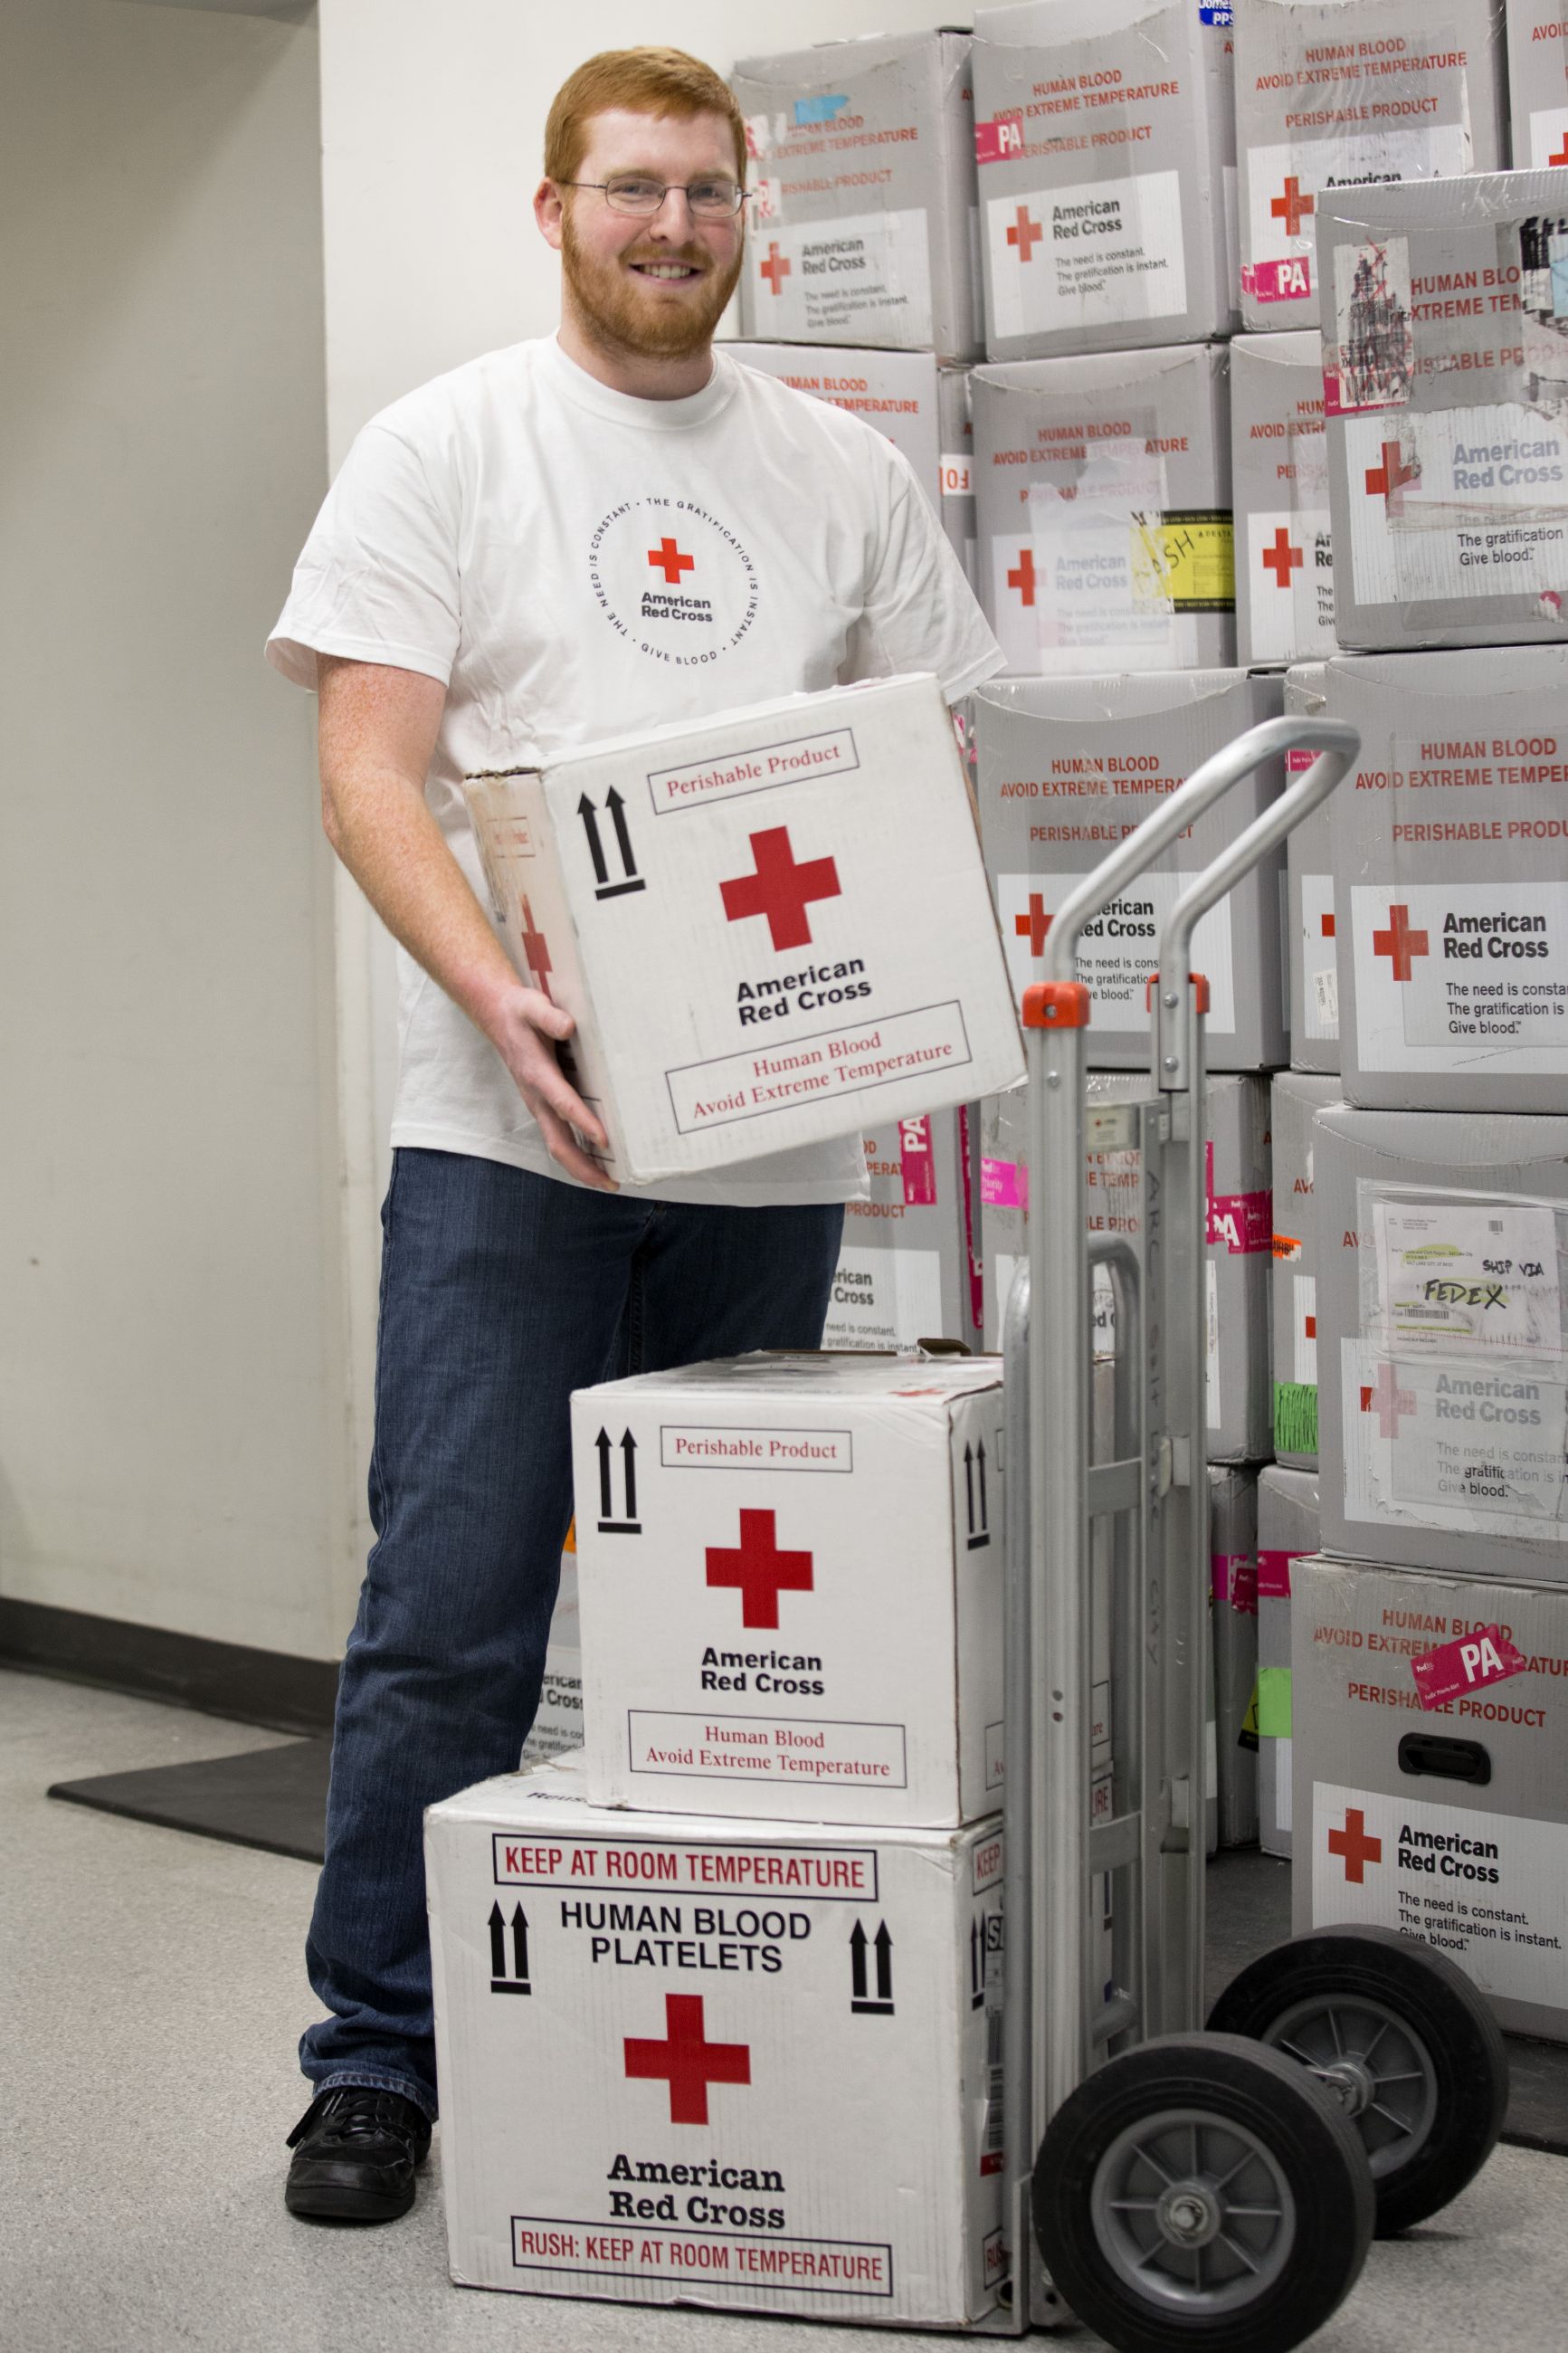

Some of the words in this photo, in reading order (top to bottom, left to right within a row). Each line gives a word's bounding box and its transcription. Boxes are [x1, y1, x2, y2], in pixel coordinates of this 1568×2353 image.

[1306, 44, 1354, 62] HUMAN
[1358, 38, 1406, 57] BLOOD
[1256, 73, 1294, 90] AVOID
[1297, 65, 1360, 84] EXTREME
[1364, 52, 1467, 76] TEMPERATURE
[1033, 78, 1076, 97] HUMAN
[1079, 70, 1122, 89] BLOOD
[1026, 97, 1080, 117] EXTREME
[1083, 81, 1179, 107] TEMPERATURE
[1286, 106, 1369, 128] PERISHABLE
[1372, 98, 1438, 118] PRODUCT
[998, 123, 1022, 153] PA
[1053, 200, 1120, 222] American
[1053, 223, 1079, 240] Red
[1081, 219, 1122, 235] Cross
[802, 240, 864, 257] American
[803, 259, 826, 275] Red
[828, 256, 866, 272] Cross
[1278, 264, 1307, 295] PA
[1411, 272, 1477, 296] HUMAN
[823, 377, 868, 392] BLOOD
[1039, 425, 1083, 442] HUMAN
[1087, 422, 1132, 438] BLOOD
[993, 451, 1028, 465] AVOID
[1030, 446, 1086, 462] EXTREME
[1452, 437, 1560, 465] American
[1453, 466, 1494, 490] Red
[1498, 464, 1563, 486] Cross
[646, 498, 670, 506] THE
[591, 502, 631, 549] CONSTANT
[677, 501, 753, 572] GRATIFICATION
[1457, 534, 1482, 547] The
[1486, 528, 1563, 548] gratification
[589, 555, 597, 567] IS
[1459, 552, 1488, 566] Give
[591, 573, 608, 608] NEED
[749, 577, 758, 590] IS
[641, 592, 711, 609] American
[607, 612, 628, 637] THE
[641, 605, 669, 618] Red
[672, 609, 713, 622] Cross
[731, 597, 758, 646] INSTANT
[641, 643, 670, 661] GIVE
[676, 651, 717, 665] BLOOD
[1421, 741, 1486, 760] HUMAN
[1492, 738, 1556, 757] BLOOD
[667, 764, 763, 798] Perishable
[768, 744, 841, 775] Product
[1052, 758, 1103, 774] HUMAN
[1108, 757, 1159, 772] BLOOD
[1001, 782, 1039, 797] AVOID
[1042, 781, 1107, 796] EXTREME
[1355, 772, 1403, 789] AVOID
[1409, 768, 1492, 787] EXTREME
[1031, 825, 1117, 841] PERISHABLE
[1392, 822, 1502, 842] PERISHABLE
[1107, 919, 1155, 937] Cross
[1443, 912, 1545, 933] American
[1444, 938, 1483, 958] Red
[1487, 938, 1548, 958] Cross
[737, 958, 865, 1003] American
[1446, 983, 1468, 995] The
[1473, 983, 1503, 995] need
[1507, 983, 1518, 995] is
[739, 1000, 790, 1027] Red
[798, 980, 872, 1011] Cross
[1447, 1003, 1469, 1015] The
[1474, 1003, 1548, 1016] gratification
[1554, 1003, 1564, 1015] is
[1449, 1021, 1476, 1034] Give
[753, 1047, 822, 1079] Human
[828, 1033, 883, 1061] Blood
[693, 1091, 746, 1119] Avoid
[752, 1072, 831, 1105] Extreme
[835, 1042, 953, 1087] Temperature
[1483, 1260, 1512, 1275] SHIP
[1519, 1262, 1544, 1277] VIA
[835, 1287, 874, 1305] Cross
[1425, 1279, 1506, 1309] FEDEX
[1436, 1374, 1541, 1400] American
[1436, 1398, 1475, 1420] Red
[1479, 1401, 1541, 1425] Cross
[676, 1438, 763, 1456] Perishable
[769, 1441, 836, 1458] Product
[1383, 1609, 1446, 1634] HUMAN
[1314, 1627, 1363, 1647] AVOID
[702, 1647, 822, 1671] American
[1460, 1637, 1504, 1683] PA
[701, 1671, 746, 1691] Red
[755, 1673, 824, 1695] Cross
[1459, 1700, 1545, 1727] PRODUCT
[706, 1726, 768, 1745] Human
[775, 1730, 824, 1748] Blood
[647, 1747, 693, 1764] Avoid
[699, 1749, 771, 1769] Extreme
[777, 1755, 889, 1777] Temperature
[1399, 1824, 1497, 1859] American
[506, 1847, 562, 1874] KEEP
[571, 1850, 598, 1876] AT
[606, 1851, 677, 1880] ROOM
[686, 1854, 864, 1888] TEMPERATURE
[1399, 1848, 1435, 1873] Red
[1440, 1855, 1499, 1883] Cross
[561, 1901, 681, 1933] HUMAN
[695, 1909, 811, 1939] BLOOD
[1398, 1891, 1420, 1906] The
[1424, 1899, 1453, 1912] need
[1458, 1901, 1468, 1915] is
[1472, 1907, 1528, 1925] constant.
[1399, 1909, 1421, 1924] The
[1424, 1918, 1496, 1939] gratification
[1501, 1928, 1510, 1940] is
[1516, 1929, 1562, 1949] instant.
[592, 1937, 782, 1973] PLATELETS
[607, 2154, 785, 2192] American
[609, 2191, 679, 2221] Red
[687, 2196, 785, 2229] Cross
[522, 2231, 579, 2258] RUSH:
[586, 2237, 633, 2262] KEEP
[641, 2241, 663, 2263] AT
[670, 2243, 728, 2269] ROOM
[735, 2247, 882, 2281] TEMPERATURE
